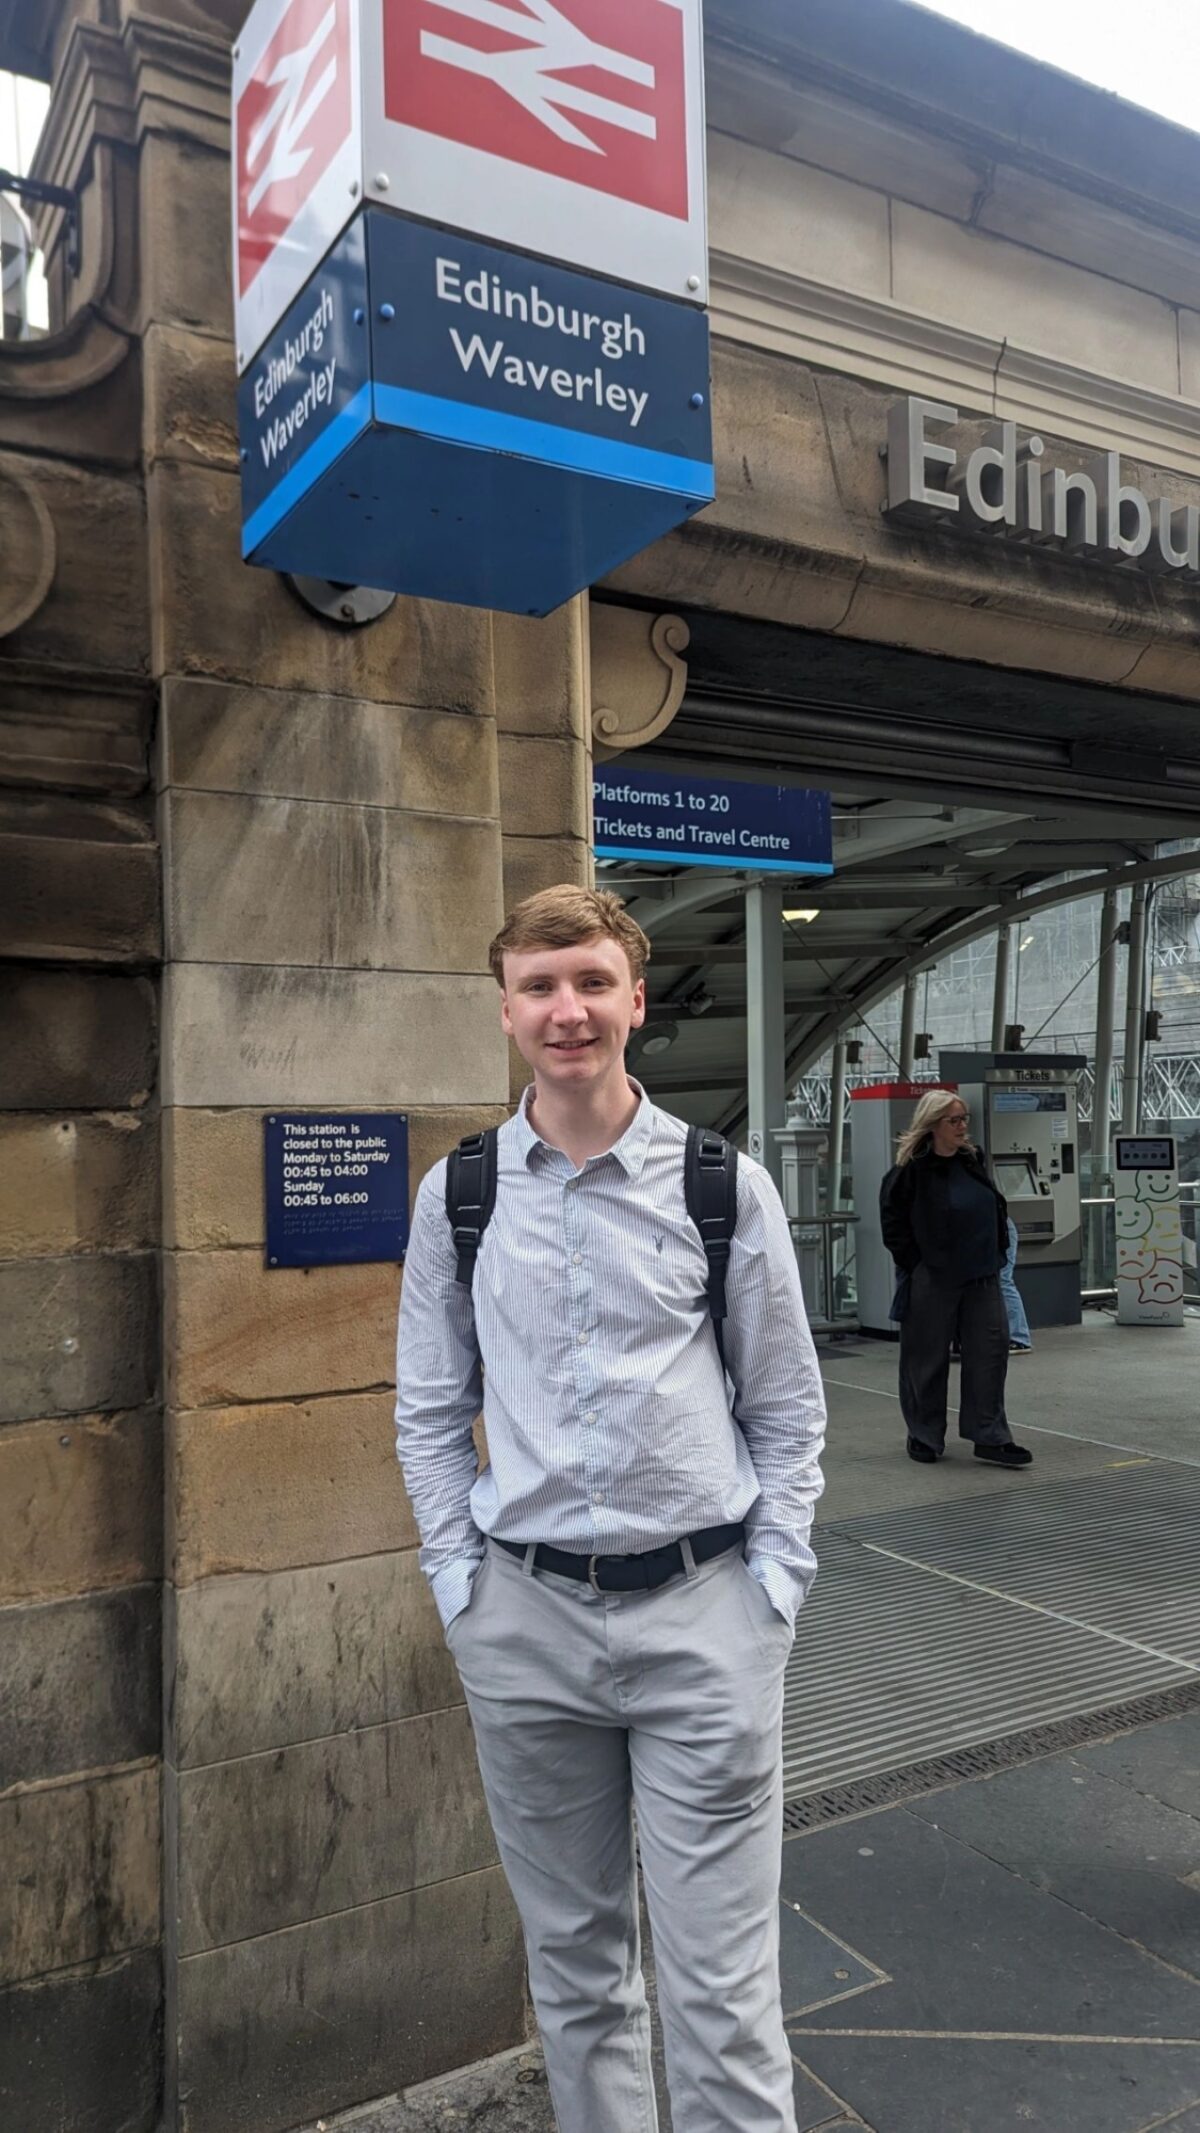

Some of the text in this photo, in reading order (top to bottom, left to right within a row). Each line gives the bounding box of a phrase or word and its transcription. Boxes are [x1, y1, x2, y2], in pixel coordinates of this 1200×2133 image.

[435, 257, 646, 360] Edinburgh
[253, 289, 334, 421] Edinburgh
[449, 328, 649, 427] Waverley
[260, 357, 338, 469] Waverley
[905, 396, 1199, 571] Edinbu
[593, 782, 730, 813] Platforms 1 to 20
[594, 816, 790, 850] Tickets and Travel Centre
[1015, 1070, 1050, 1081] Tickets
[283, 1124, 360, 1135] This station is
[283, 1137, 387, 1150] closed to the public
[283, 1151, 390, 1165] Monday to Saturday
[283, 1165, 368, 1178] 00:45 to 04:00
[284, 1181, 325, 1194] Sunday
[283, 1193, 368, 1207] 00:45 to 06:00
